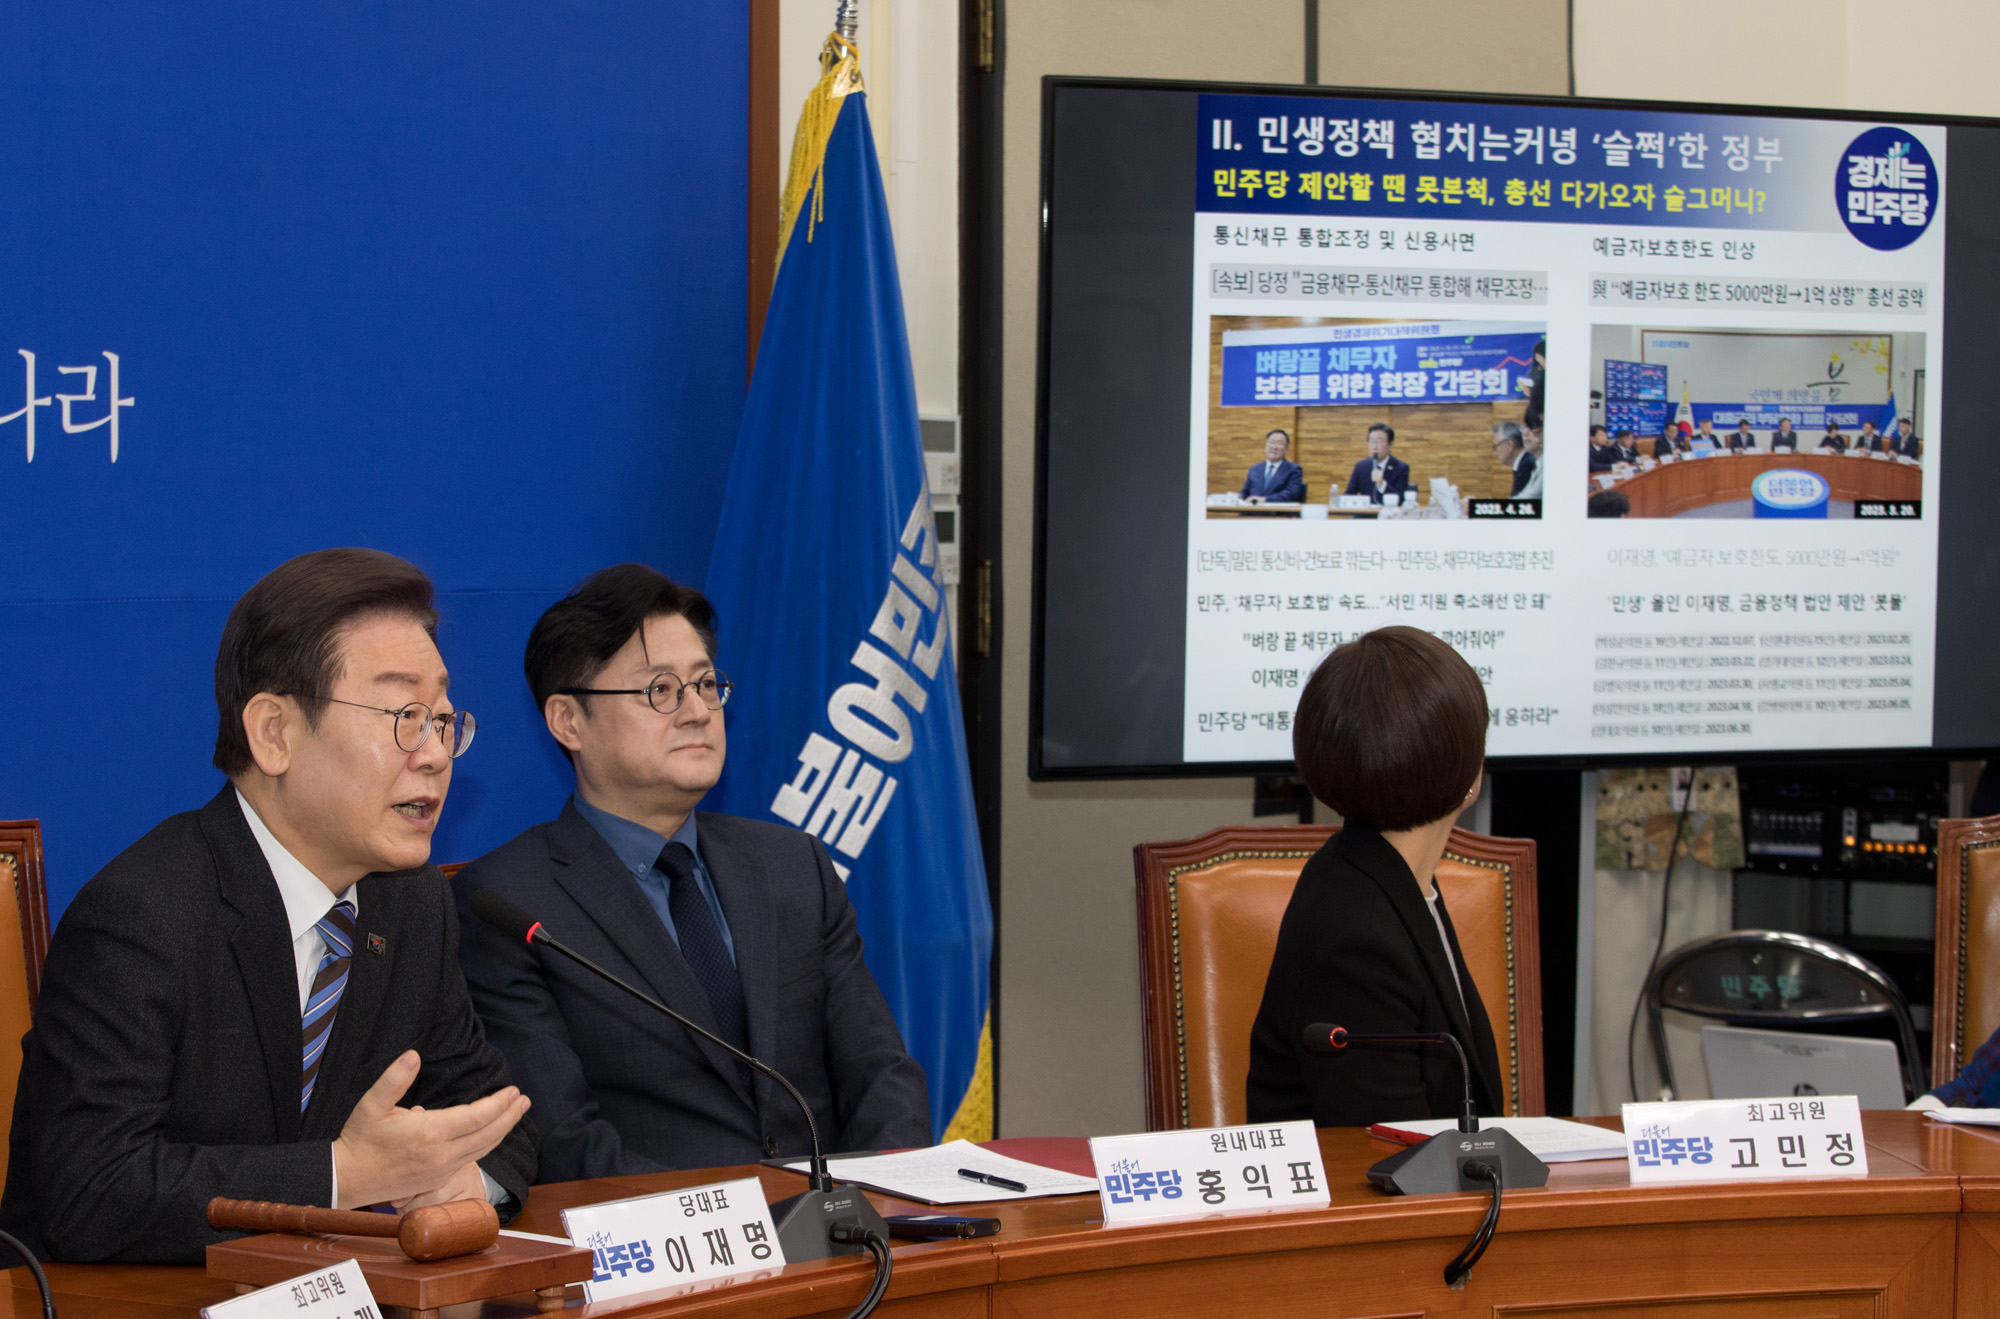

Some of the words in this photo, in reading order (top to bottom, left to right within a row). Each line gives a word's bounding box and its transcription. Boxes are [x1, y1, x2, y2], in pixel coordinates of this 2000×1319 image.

[1258, 115, 1395, 159] 민생정책
[1410, 120, 1578, 166] 협치는커녕
[1721, 134, 1784, 174] 정부
[1848, 141, 1927, 191] 경제는
[1213, 168, 1289, 199] 민주당
[1298, 170, 1373, 201] 제안할
[1382, 173, 1407, 203] 땐
[1416, 175, 1496, 206] 못본척,
[1504, 178, 1552, 208] 총선
[1561, 180, 1656, 212] 다가오자
[1663, 183, 1767, 214] 슬그머니?
[1847, 191, 1929, 227] 민주당
[1213, 225, 1289, 248] 통신채무
[1297, 227, 1371, 250] 통합조정
[1379, 229, 1396, 251] 및
[1404, 230, 1475, 253] 신용사면
[1592, 237, 1715, 259] 예금자보호한도
[1721, 239, 1756, 261] 인상
[1212, 269, 1254, 295] [속보]
[1258, 270, 1288, 295] 당정
[1428, 274, 1471, 299] 통합해
[1694, 281, 1721, 302] 한도
[1867, 287, 1893, 308] 총선
[1897, 288, 1924, 309] 공약
[1327, 345, 1397, 372] 채무자
[1255, 374, 1321, 401] 보호를
[1326, 372, 1375, 399] 위한
[1379, 370, 1429, 398] 현장
[1433, 368, 1508, 397] 간담회
[1528, 550, 1554, 571] 추진
[1197, 594, 1229, 613] 민주,
[1421, 594, 1447, 611] 지원
[1453, 593, 1508, 610] 축소해선
[1513, 593, 1526, 610] 안
[1651, 594, 1680, 613] 올인
[1739, 593, 1798, 613] 금융정책
[1803, 593, 1832, 612] 법안
[1837, 593, 1865, 612] 제안
[1284, 631, 1298, 652] 끝
[1252, 668, 1299, 688] 이재명
[1198, 711, 1248, 733] 민주당
[1747, 1101, 1826, 1122] 최고위원
[1210, 1128, 1286, 1153] 원내대표
[1640, 1124, 1671, 1139] 더불어
[1632, 1136, 1714, 1167] 민주당
[1111, 1158, 1141, 1174] 더불어
[1104, 1169, 1183, 1204] 민주당
[678, 1188, 730, 1218] 당대표
[586, 1231, 614, 1249] 더불어
[291, 1271, 346, 1308] 최고위원
